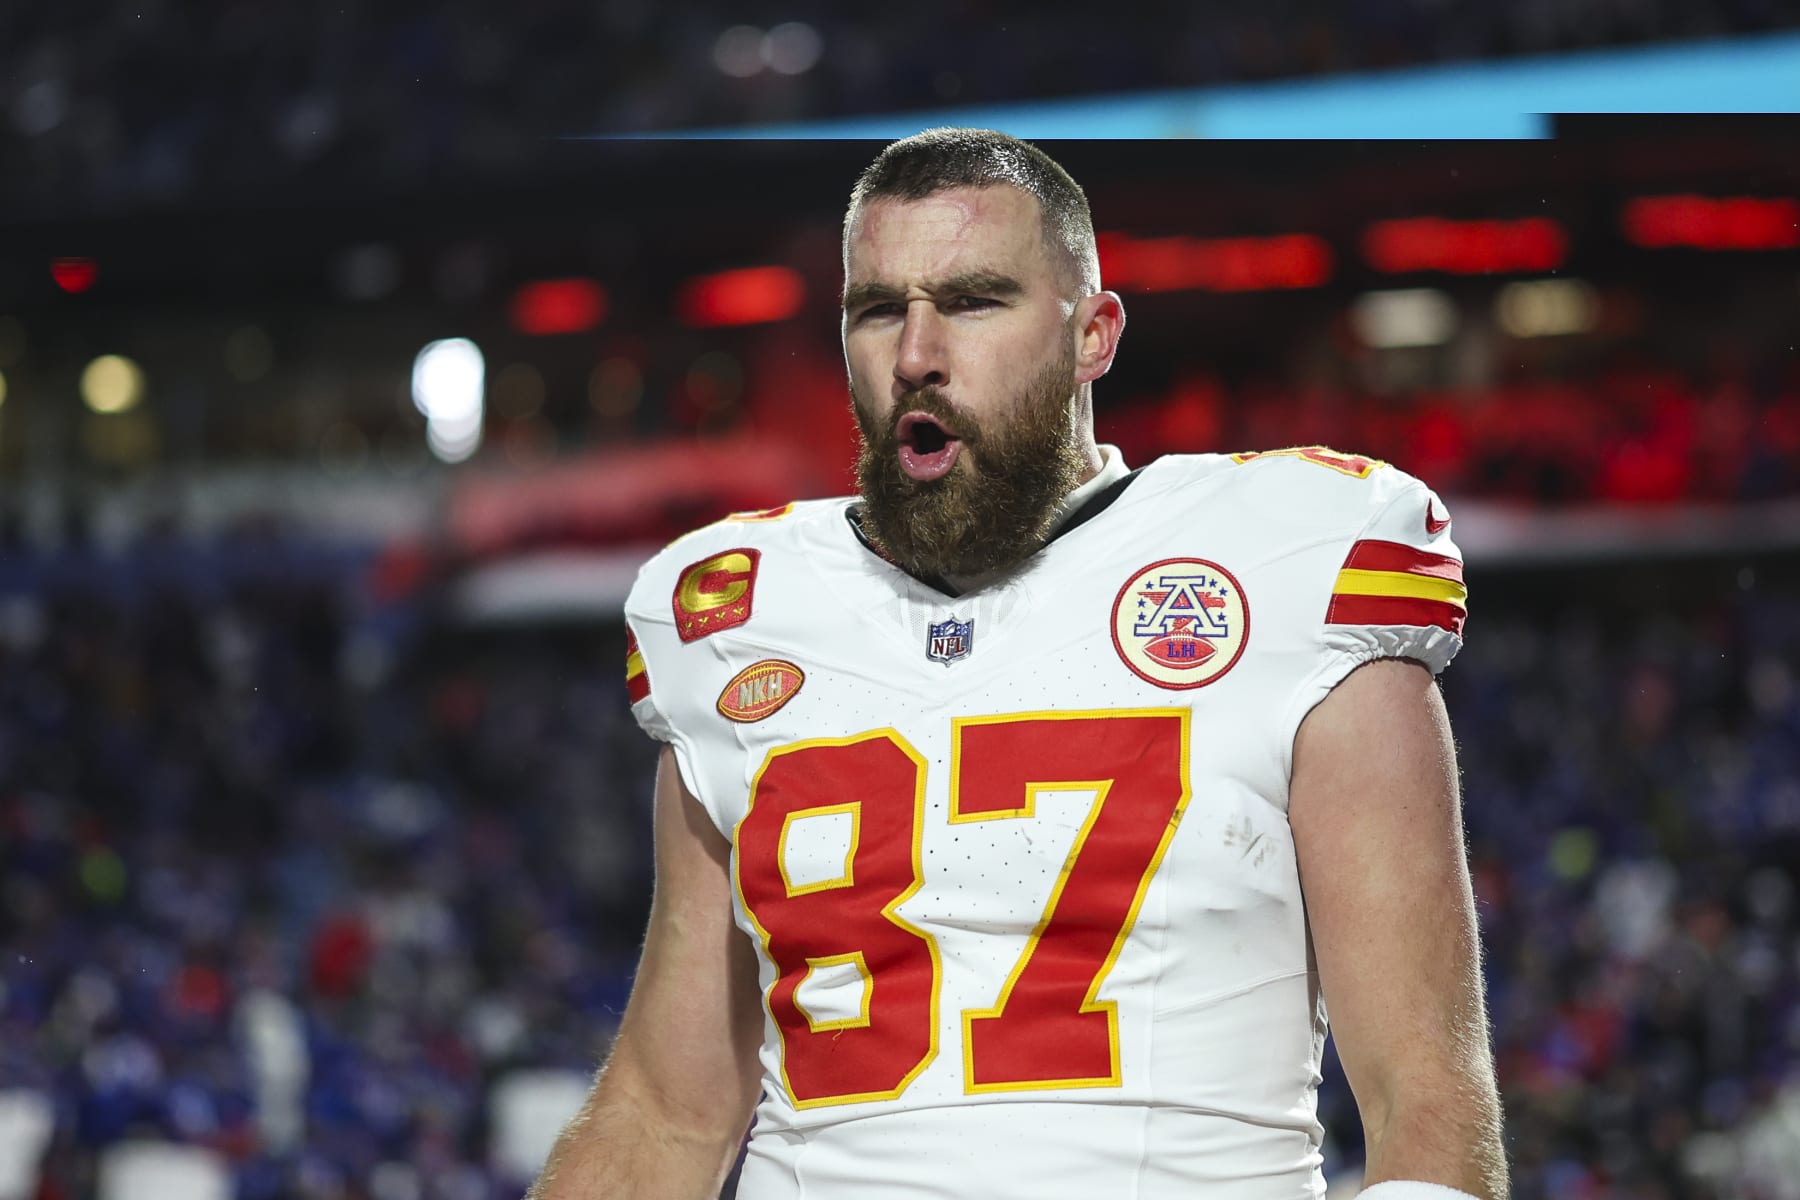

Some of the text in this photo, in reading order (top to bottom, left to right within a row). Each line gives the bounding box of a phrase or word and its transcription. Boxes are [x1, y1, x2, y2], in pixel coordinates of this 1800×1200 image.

[679, 553, 751, 614] C
[932, 636, 966, 657] NFL
[1167, 641, 1197, 658] LH
[738, 671, 783, 709] NKH
[733, 706, 1193, 1111] 87
